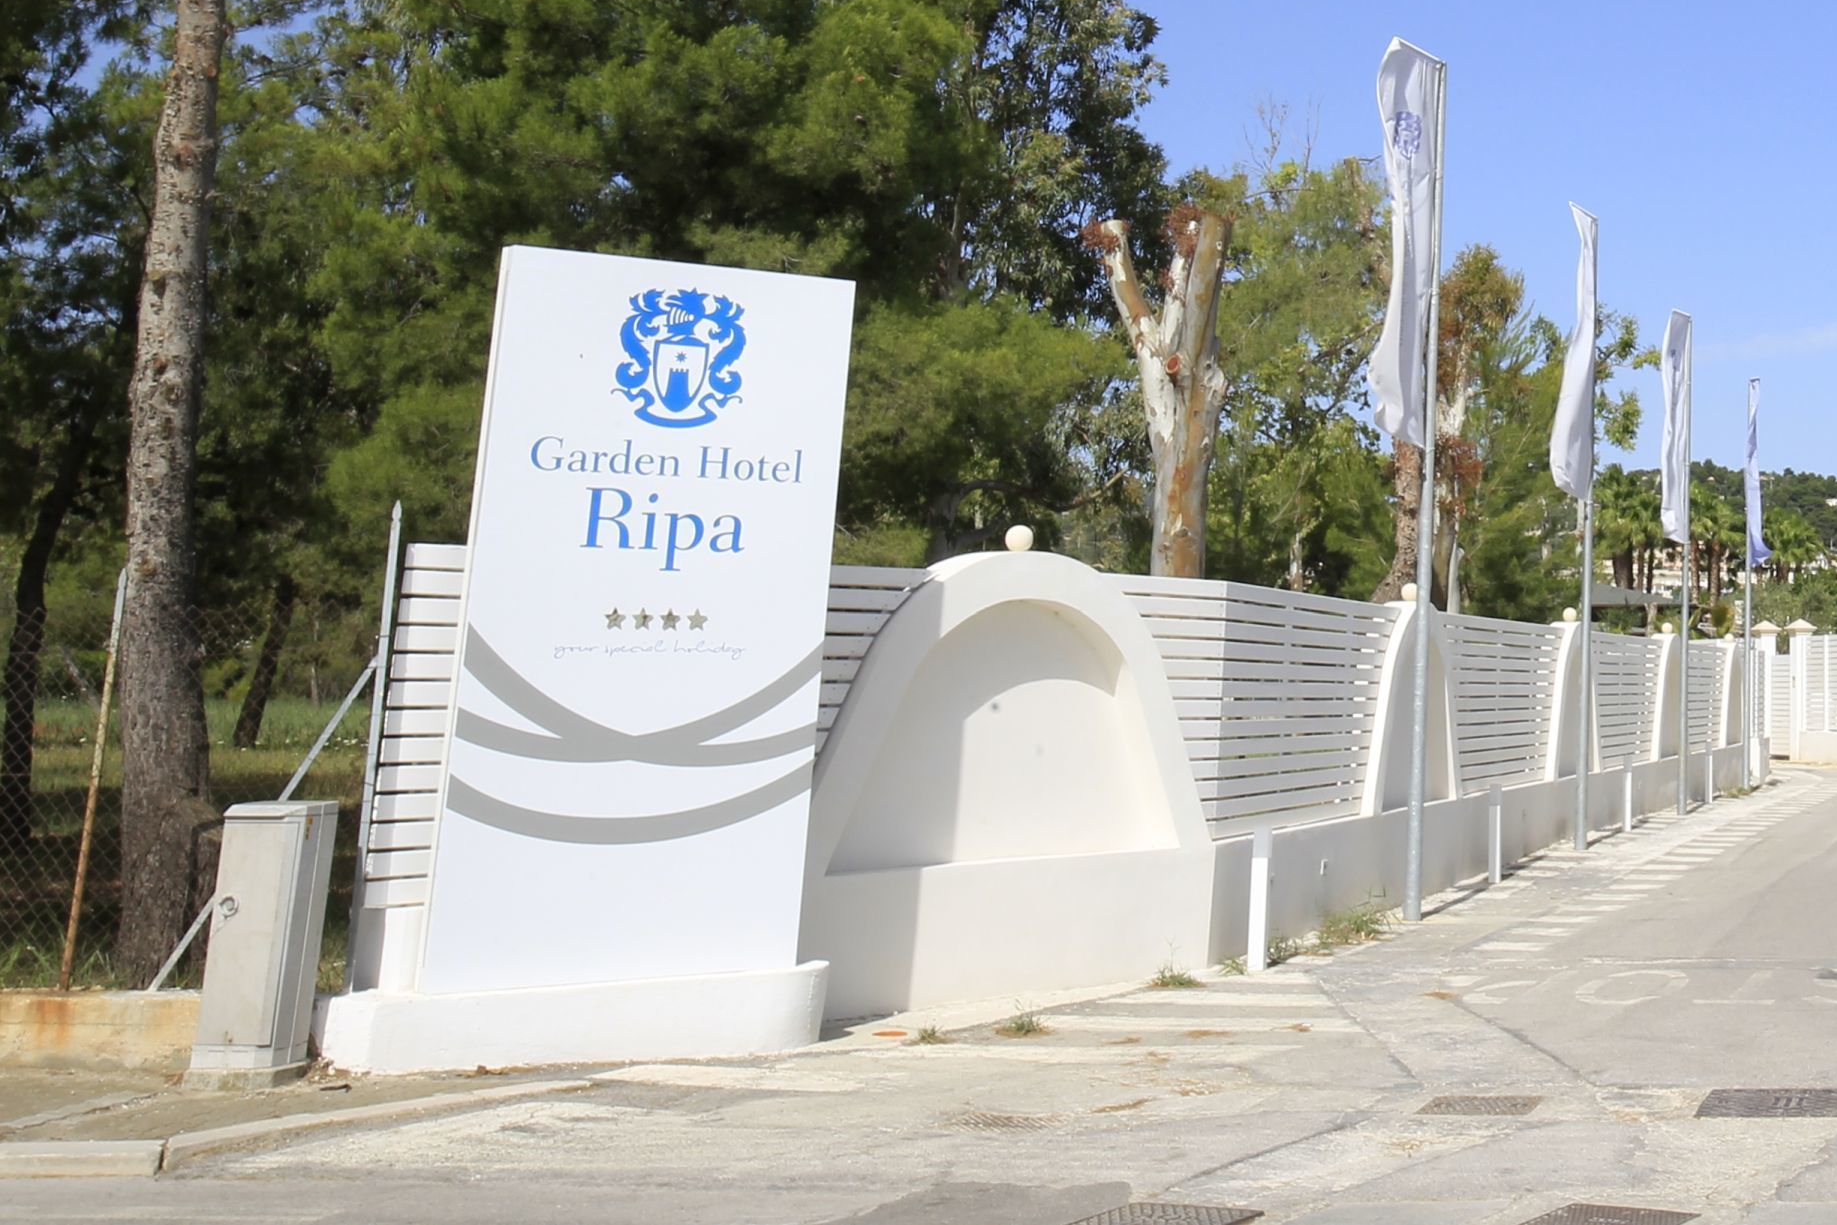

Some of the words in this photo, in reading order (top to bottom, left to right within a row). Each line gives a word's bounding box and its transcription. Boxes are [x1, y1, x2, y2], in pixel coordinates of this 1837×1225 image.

[531, 436, 679, 476] Garden
[698, 446, 802, 483] Hotel
[580, 487, 744, 571] Ripa
[554, 646, 598, 659] your
[605, 640, 667, 657] special
[674, 640, 746, 660] holiday
